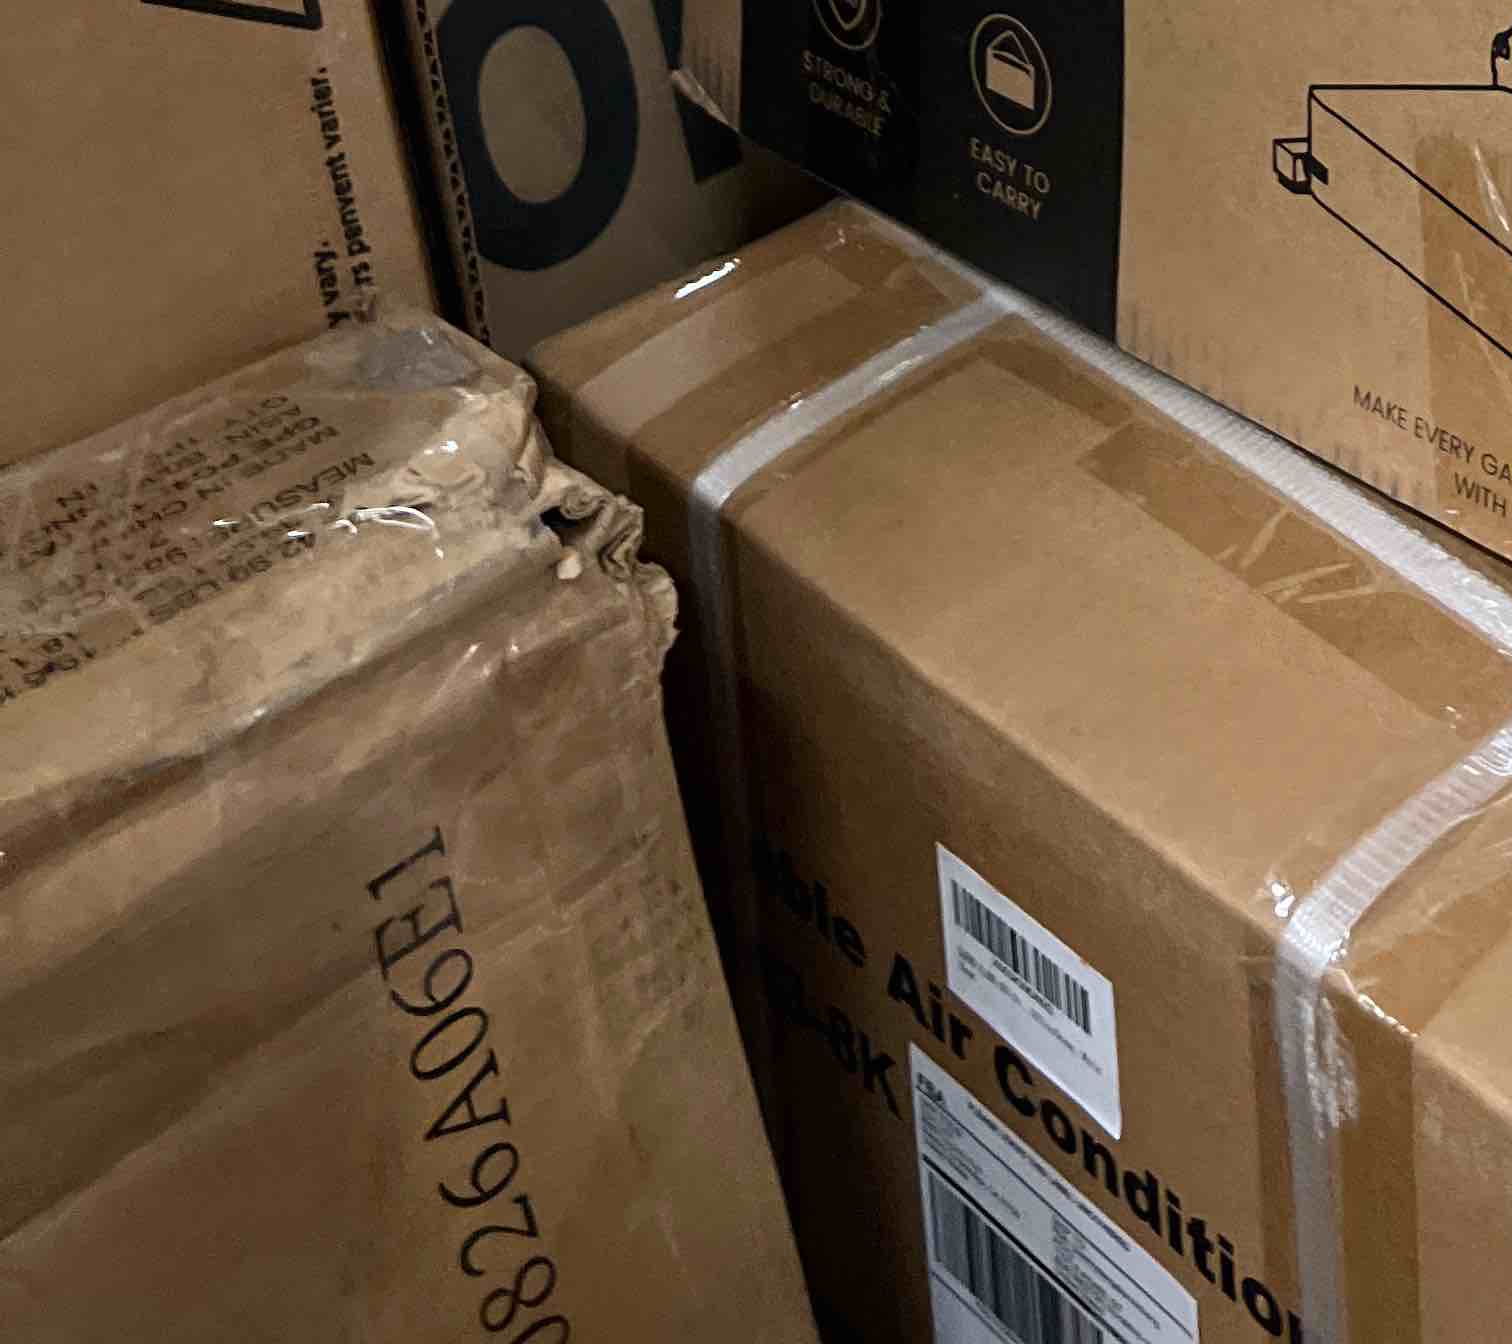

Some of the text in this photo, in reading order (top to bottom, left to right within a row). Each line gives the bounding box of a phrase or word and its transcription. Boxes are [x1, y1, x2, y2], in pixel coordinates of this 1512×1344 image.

[800, 48, 875, 104] STRONG
[968, 136, 1051, 195] EASY TO
[976, 171, 1043, 221] CARRY
[1351, 384, 1409, 431] MAKE
[1413, 416, 1475, 464] EVERY
[1452, 472, 1507, 517] WITH
[887, 952, 973, 1060] Air
